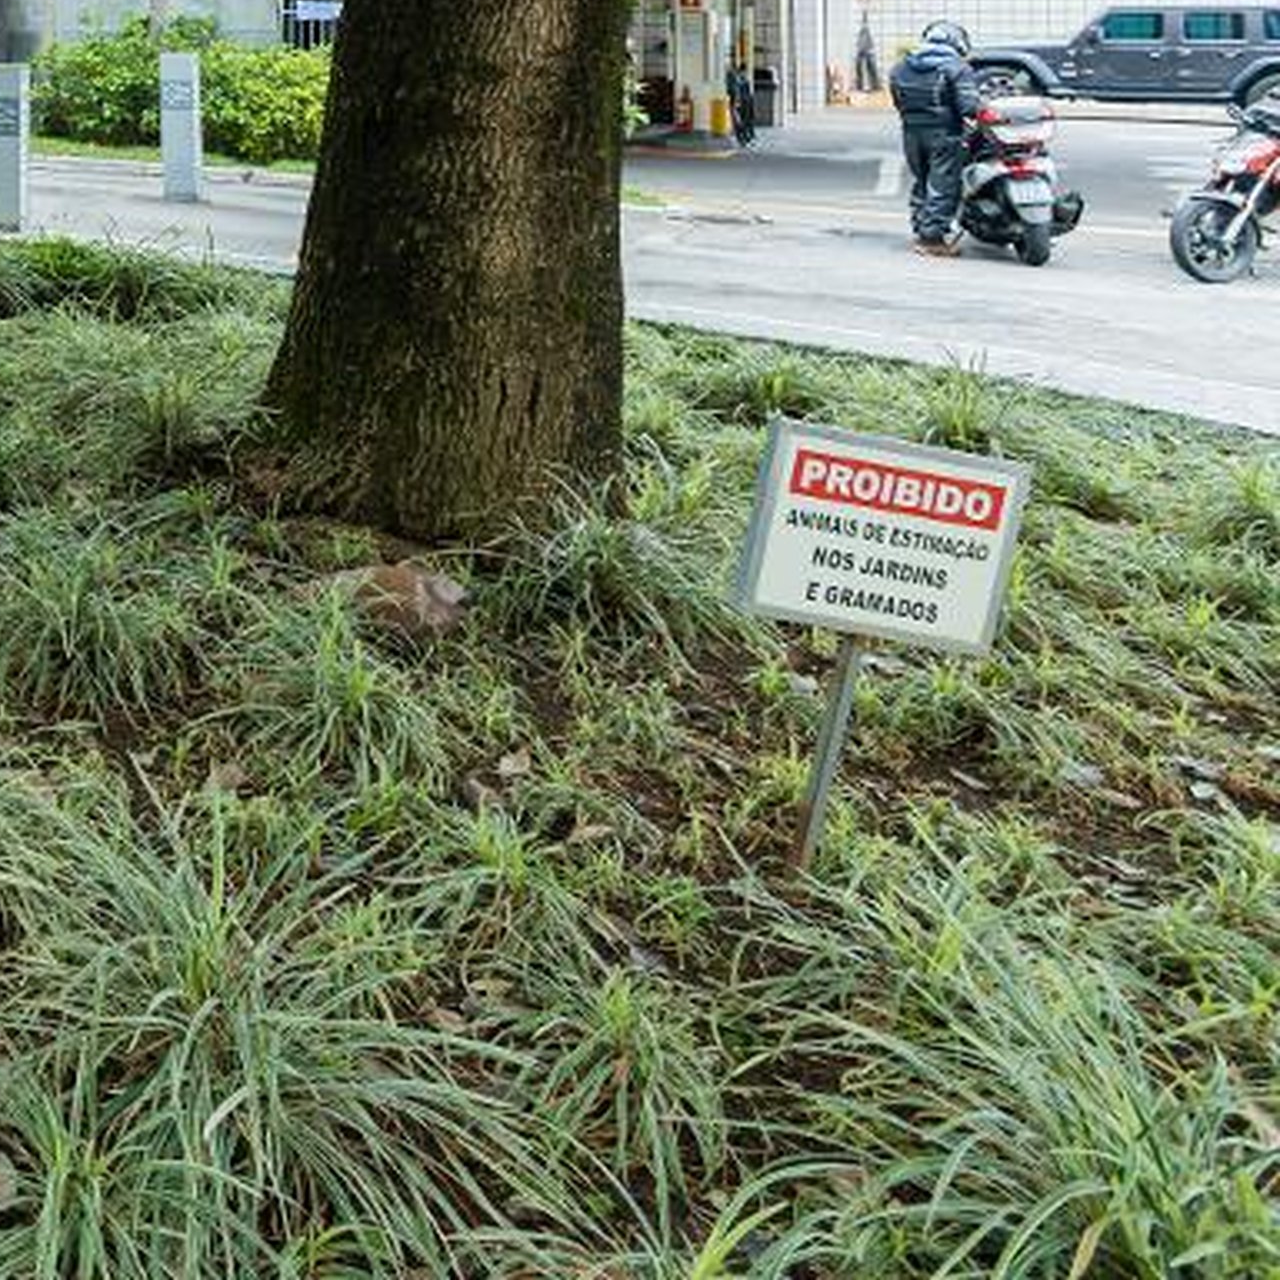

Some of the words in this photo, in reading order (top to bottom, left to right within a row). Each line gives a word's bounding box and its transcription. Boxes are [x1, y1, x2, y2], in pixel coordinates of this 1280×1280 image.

[800, 459, 992, 520] PROIBIDO
[786, 509, 858, 537] ANIMAIS
[862, 522, 888, 544] DE
[890, 528, 989, 561] ESTIMAÇÃO
[812, 546, 855, 571] NOS
[859, 557, 947, 590] JARDINS
[805, 581, 821, 601] E
[825, 586, 938, 623] GRAMADOS
